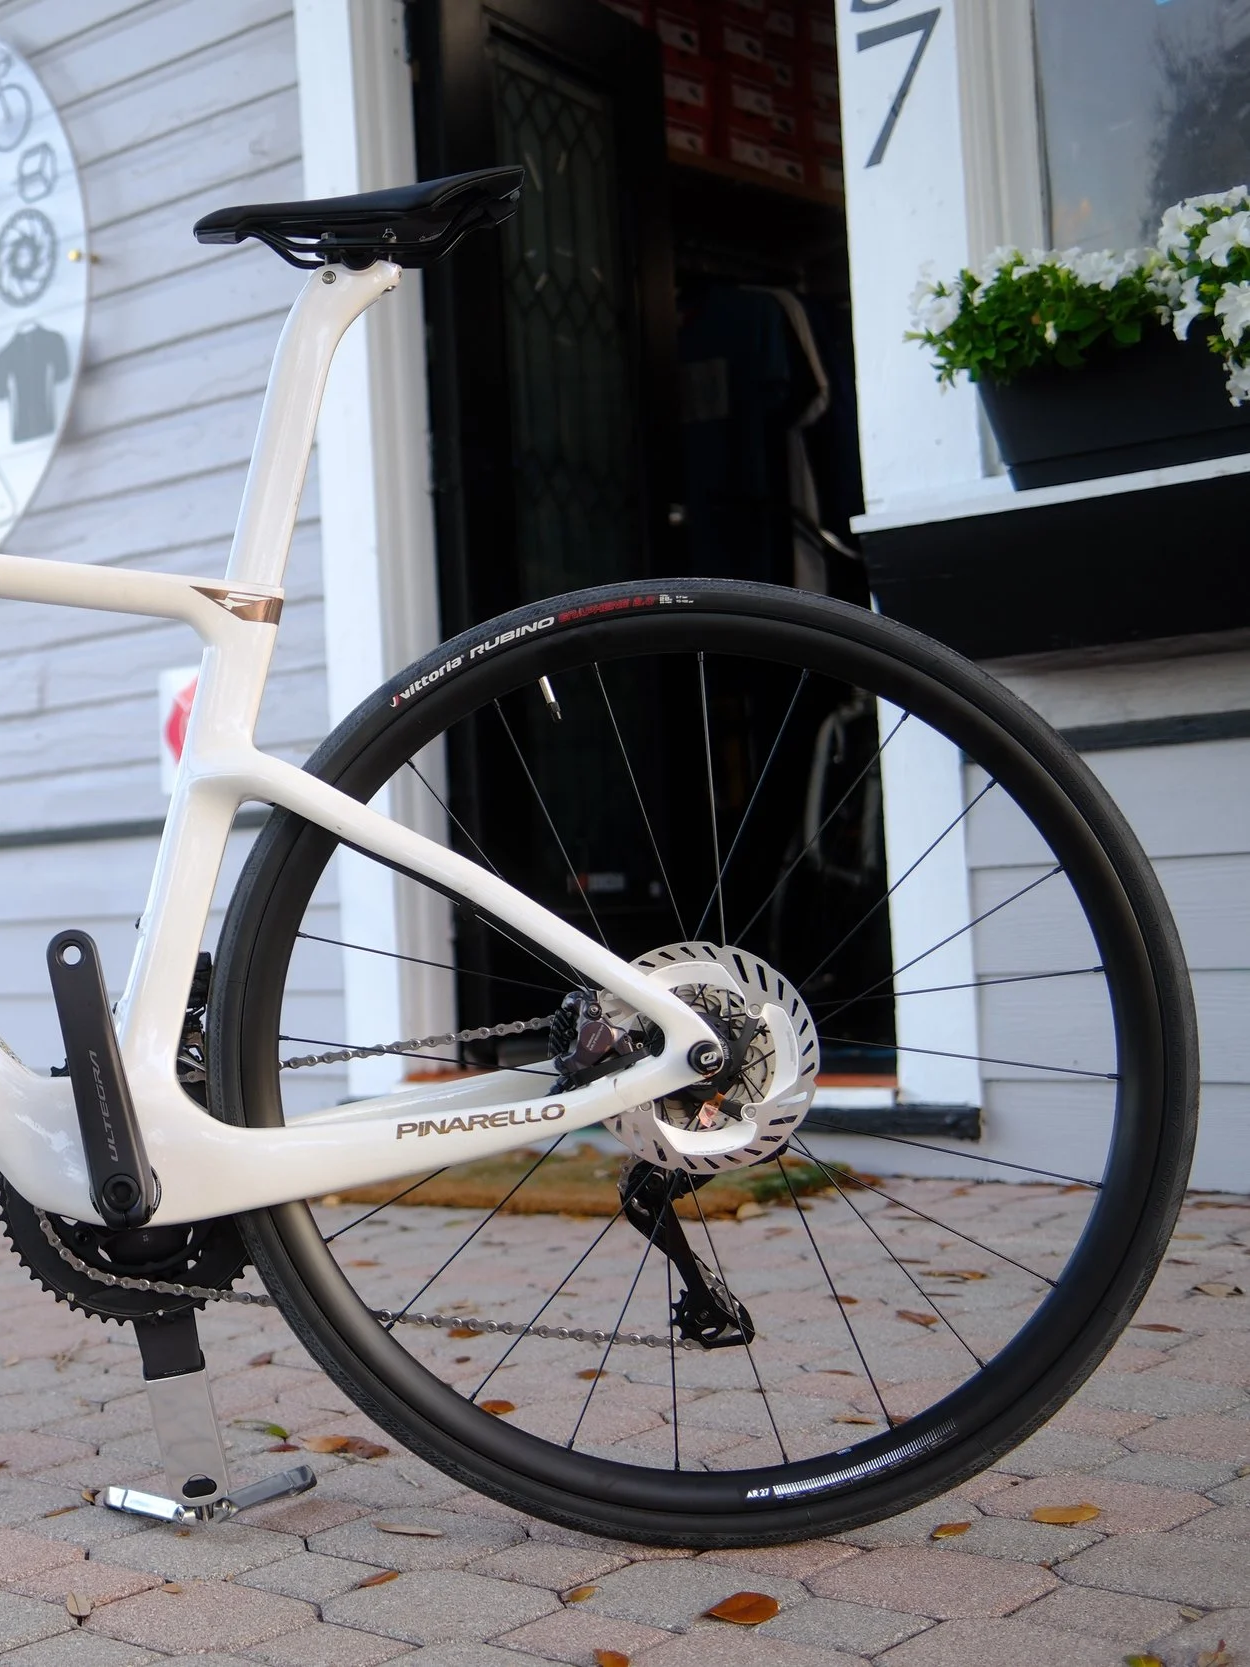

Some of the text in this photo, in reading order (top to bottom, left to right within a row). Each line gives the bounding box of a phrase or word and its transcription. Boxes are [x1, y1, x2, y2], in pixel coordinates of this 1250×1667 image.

[850, 0, 942, 169] 7
[399, 656, 463, 700] vittoria
[470, 616, 555, 660] RUBINO
[88, 1048, 119, 1162] ULTEGRA
[395, 1103, 566, 1140] PINARELLO
[746, 1487, 770, 1499] AR 27
